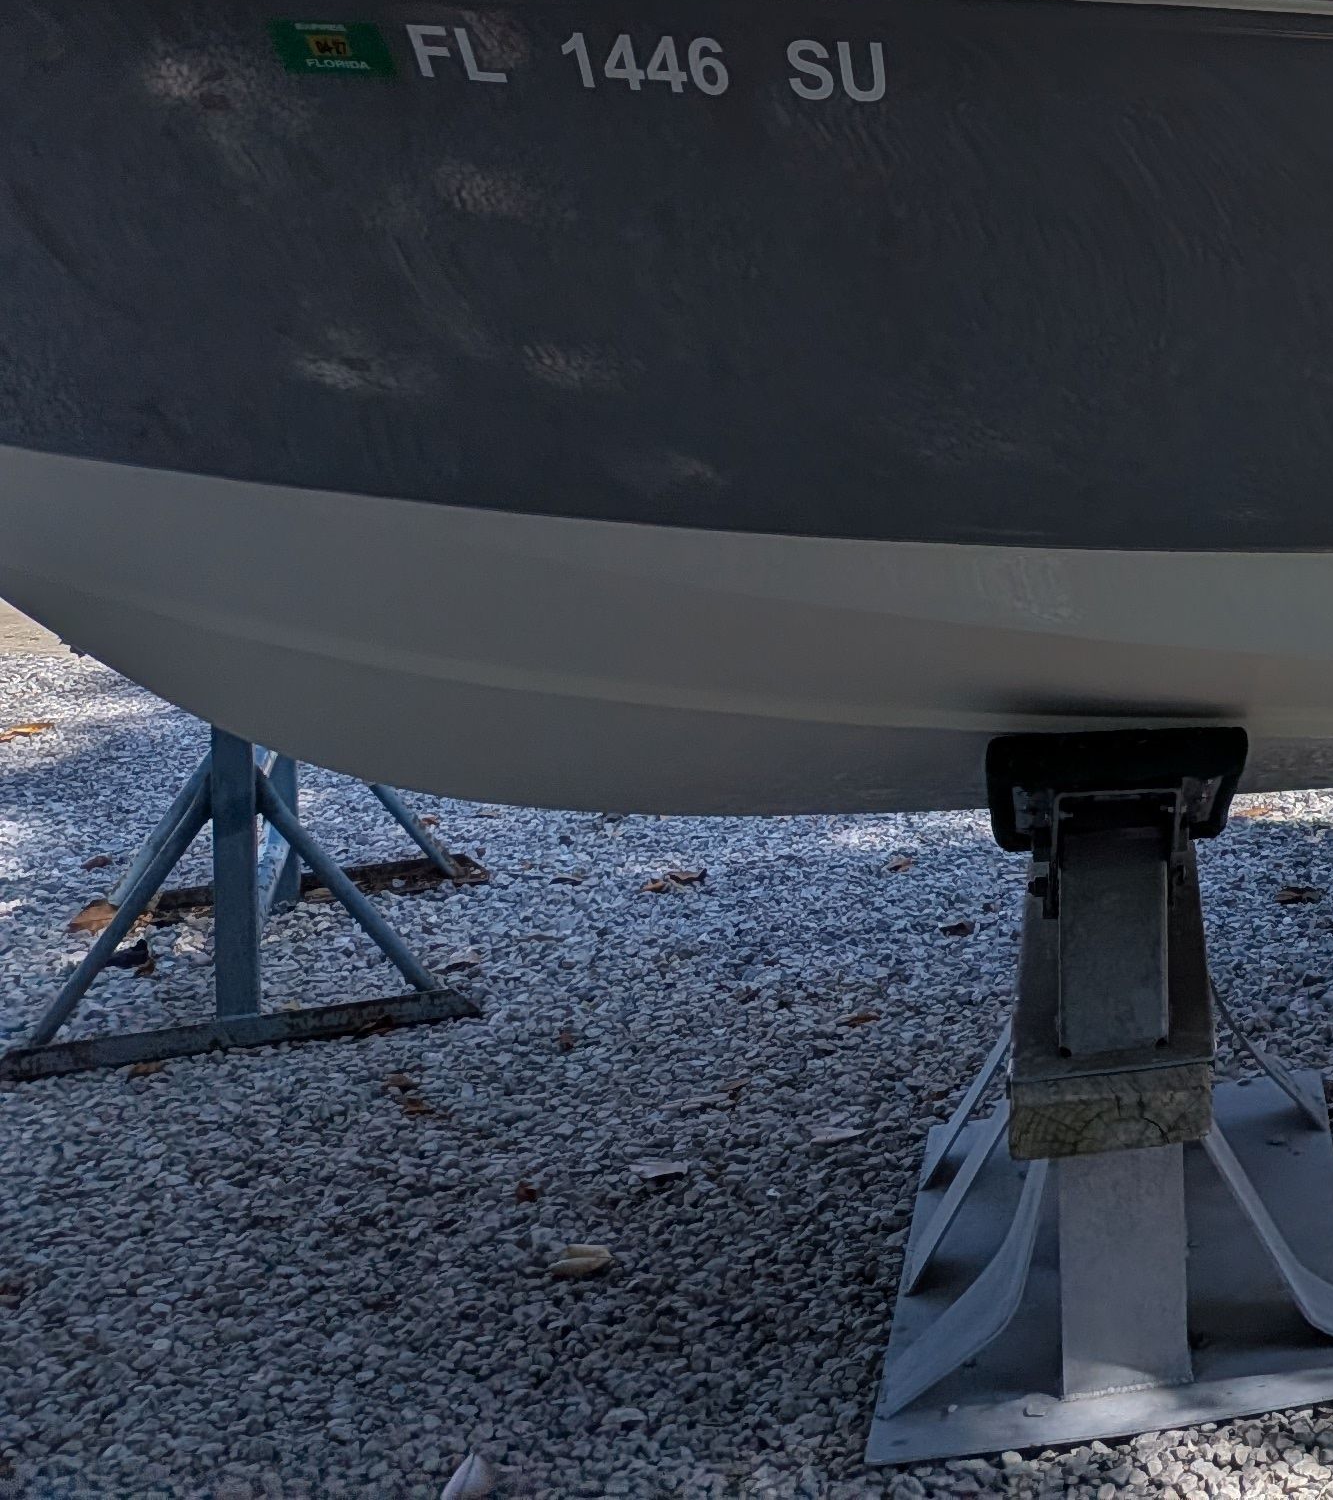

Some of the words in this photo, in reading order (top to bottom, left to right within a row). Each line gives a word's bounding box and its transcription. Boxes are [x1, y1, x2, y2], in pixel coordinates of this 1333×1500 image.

[305, 58, 371, 70] FLORIDA
[406, 24, 507, 83] FL
[561, 32, 729, 95] 1446
[788, 40, 887, 101] SU
